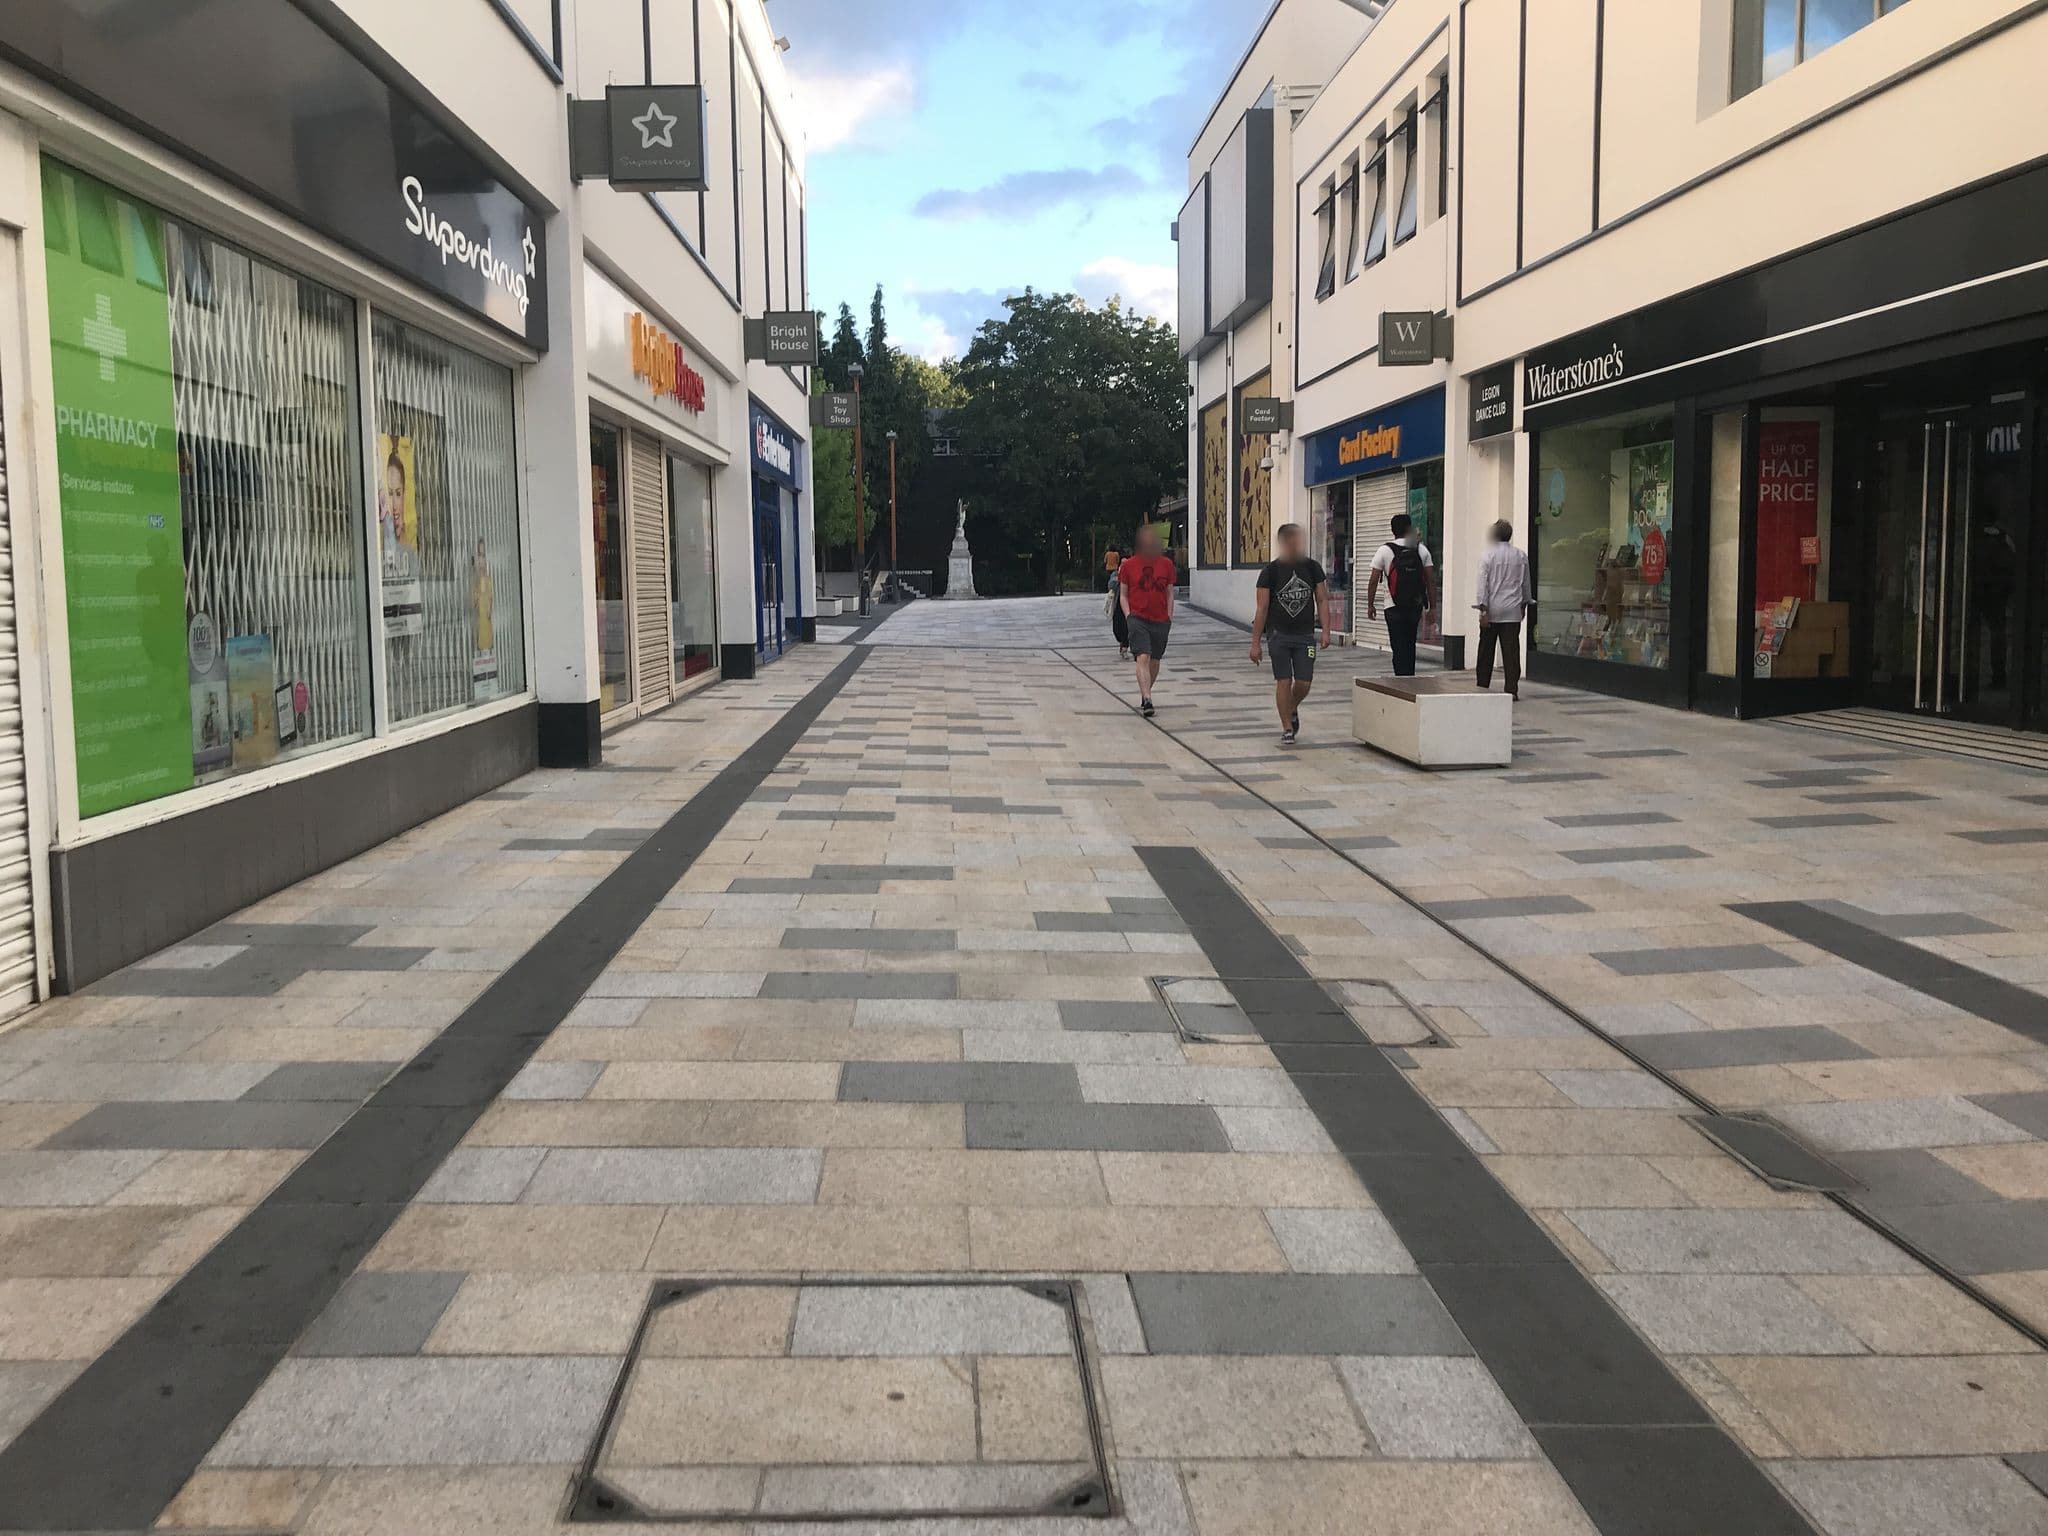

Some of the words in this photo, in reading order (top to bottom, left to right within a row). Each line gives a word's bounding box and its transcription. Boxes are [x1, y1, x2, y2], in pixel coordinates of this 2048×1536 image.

[402, 176, 529, 316] Superdrug
[770, 325, 808, 339] Bright
[1395, 321, 1421, 342] W
[770, 340, 809, 350] House
[1528, 343, 1624, 400] Waterstone's
[1482, 384, 1501, 401] LEGION
[834, 406, 847, 415] Toy
[1475, 405, 1492, 422] DANCE
[1493, 401, 1507, 417] CLUB
[56, 404, 159, 449] PHARMACY
[830, 416, 851, 425] Shop
[1339, 432, 1360, 466] Card
[1361, 425, 1400, 459] Factory
[1771, 444, 1786, 456] UP
[1791, 443, 1806, 455] TO
[1761, 459, 1815, 478] HALF
[62, 472, 102, 492] Services
[1643, 488, 1657, 501] FOR
[1759, 482, 1815, 502] PRICE
[149, 515, 165, 528] NHS
